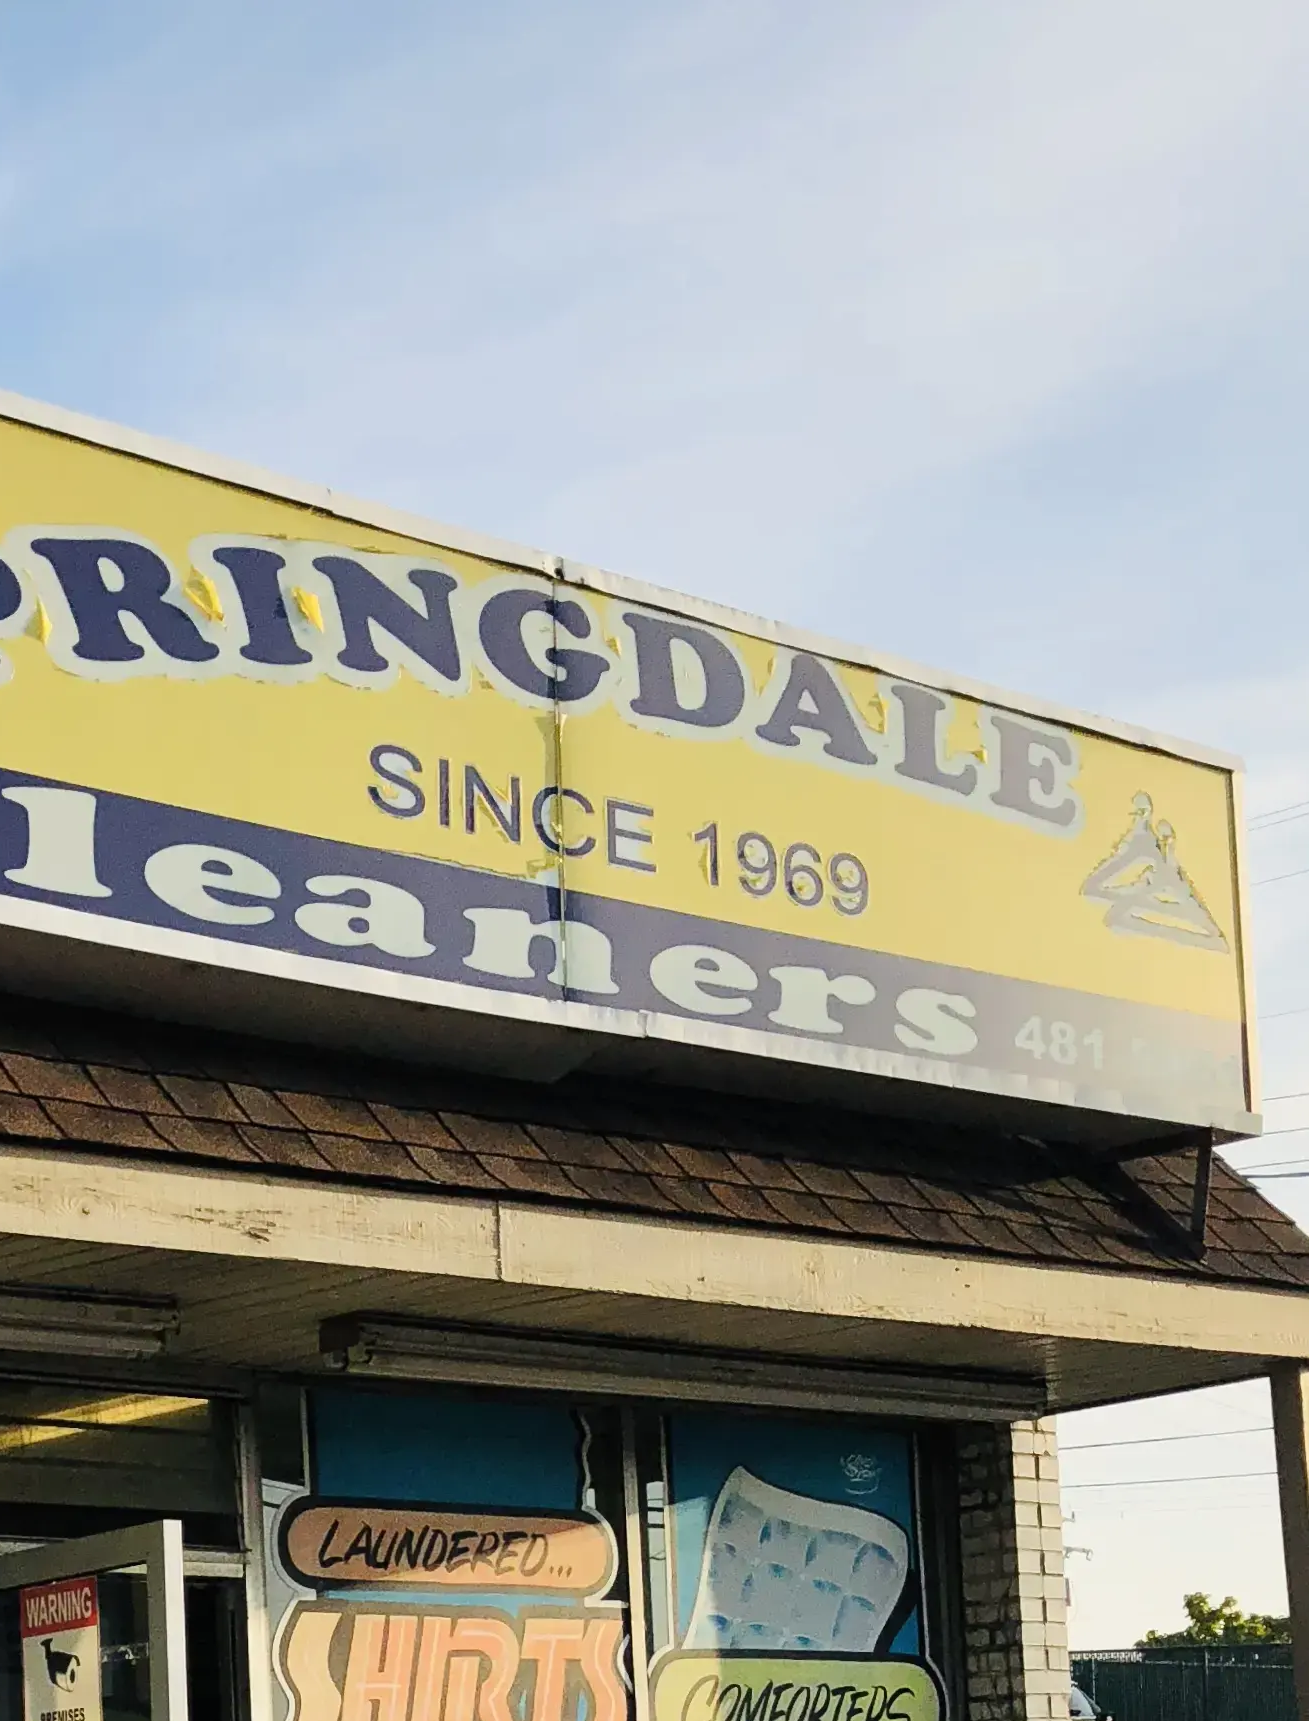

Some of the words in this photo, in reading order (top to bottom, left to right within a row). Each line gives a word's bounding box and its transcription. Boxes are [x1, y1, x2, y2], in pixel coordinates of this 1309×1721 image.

[367, 744, 657, 874] SINCE
[692, 820, 870, 916] 1969
[25, 1587, 92, 1629] WARNING
